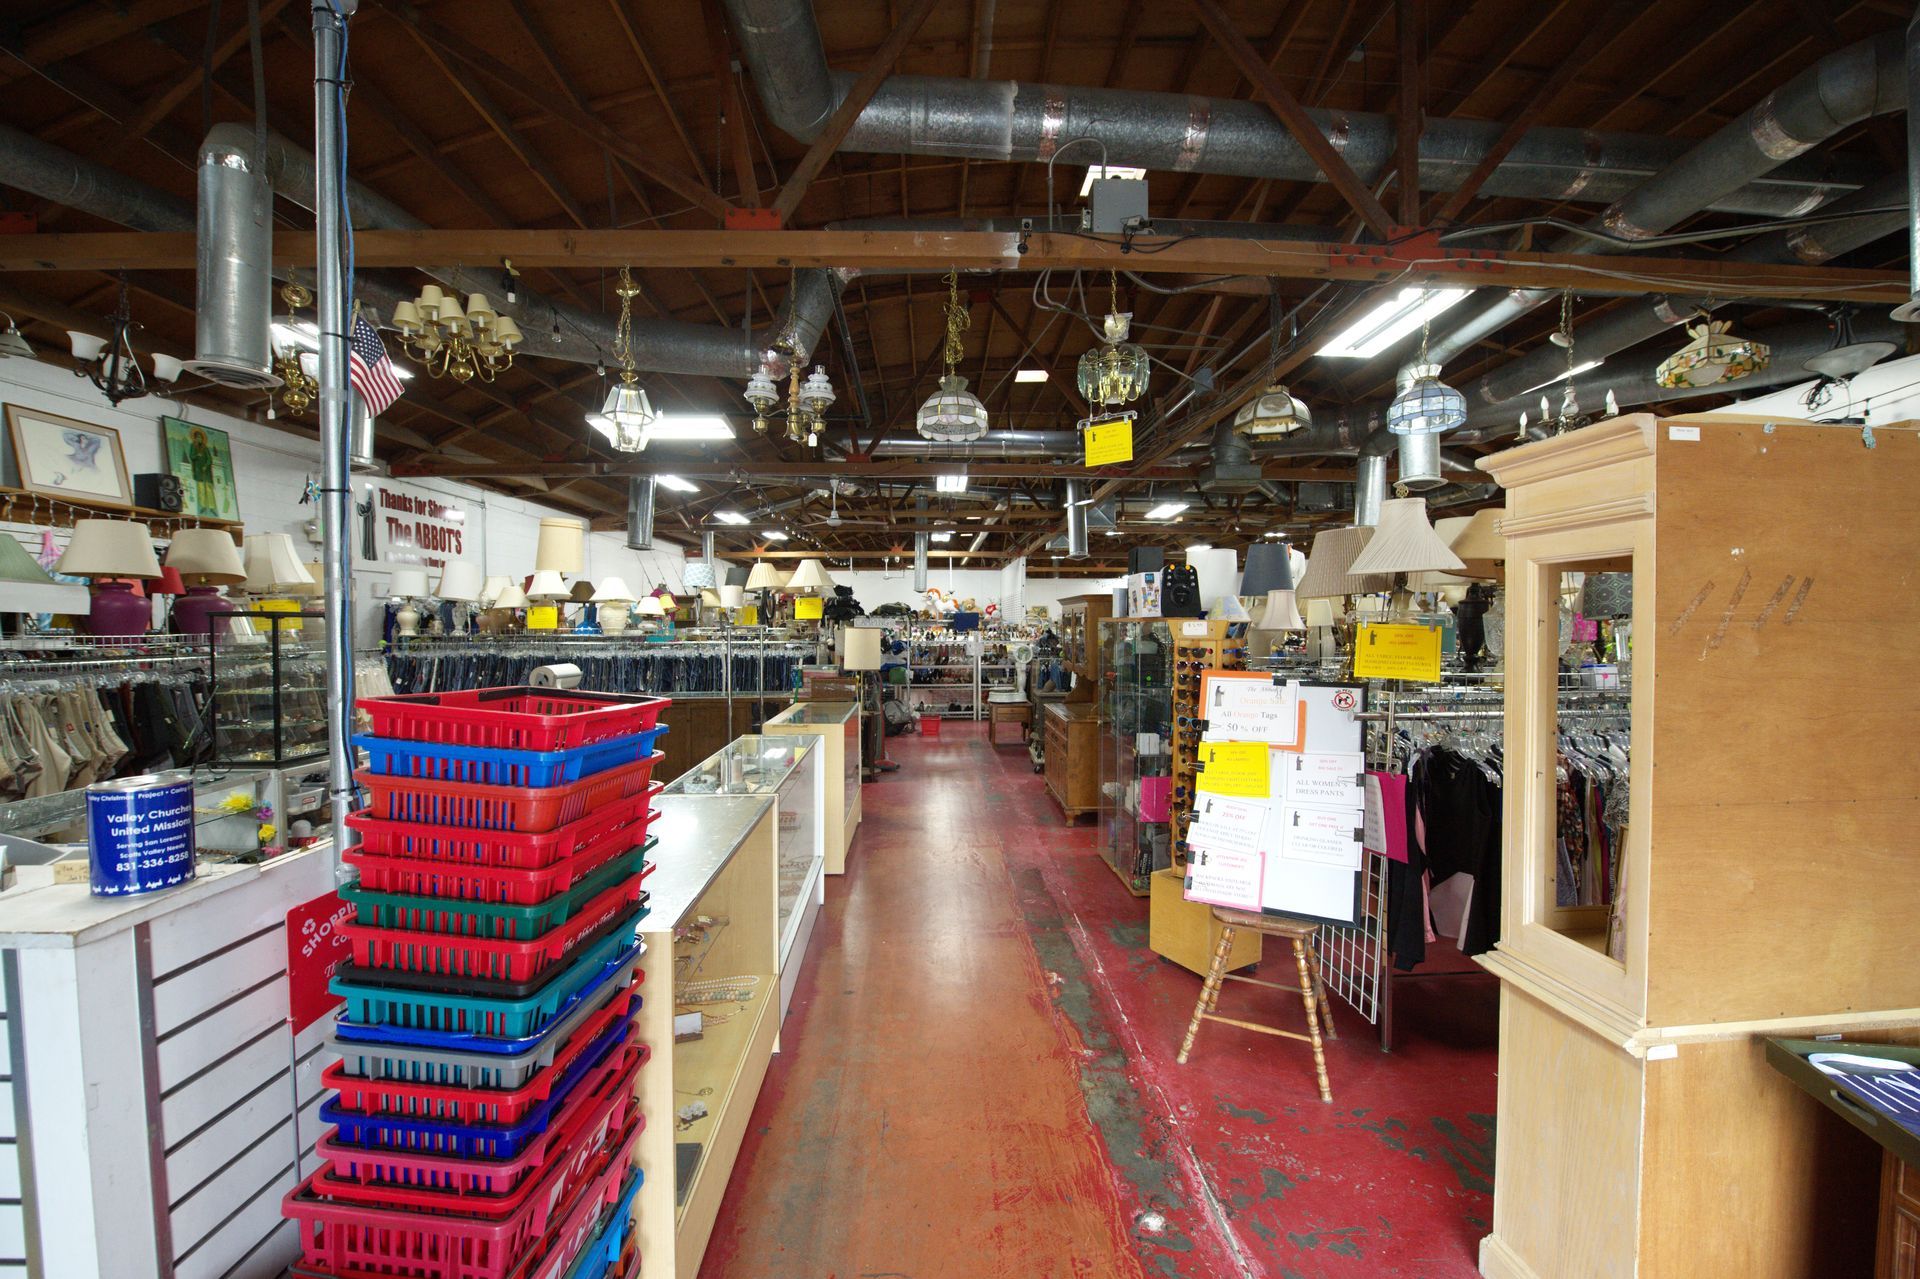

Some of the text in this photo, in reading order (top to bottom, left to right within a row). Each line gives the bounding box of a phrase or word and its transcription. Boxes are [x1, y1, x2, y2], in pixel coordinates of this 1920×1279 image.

[378, 487, 413, 513] Thanks
[414, 496, 427, 516] for
[386, 516, 462, 555] The ABBOT'S
[1234, 711, 1258, 720] Orange
[1261, 712, 1278, 720] Tags
[1227, 722, 1239, 732] 50
[138, 790, 164, 800] Project
[107, 812, 146, 824] Valley
[111, 823, 151, 837] United
[116, 841, 143, 850] Serving
[144, 838, 159, 847] San
[143, 847, 165, 856] Valley
[167, 842, 186, 852] Needy
[116, 850, 189, 872] 831-336-8258
